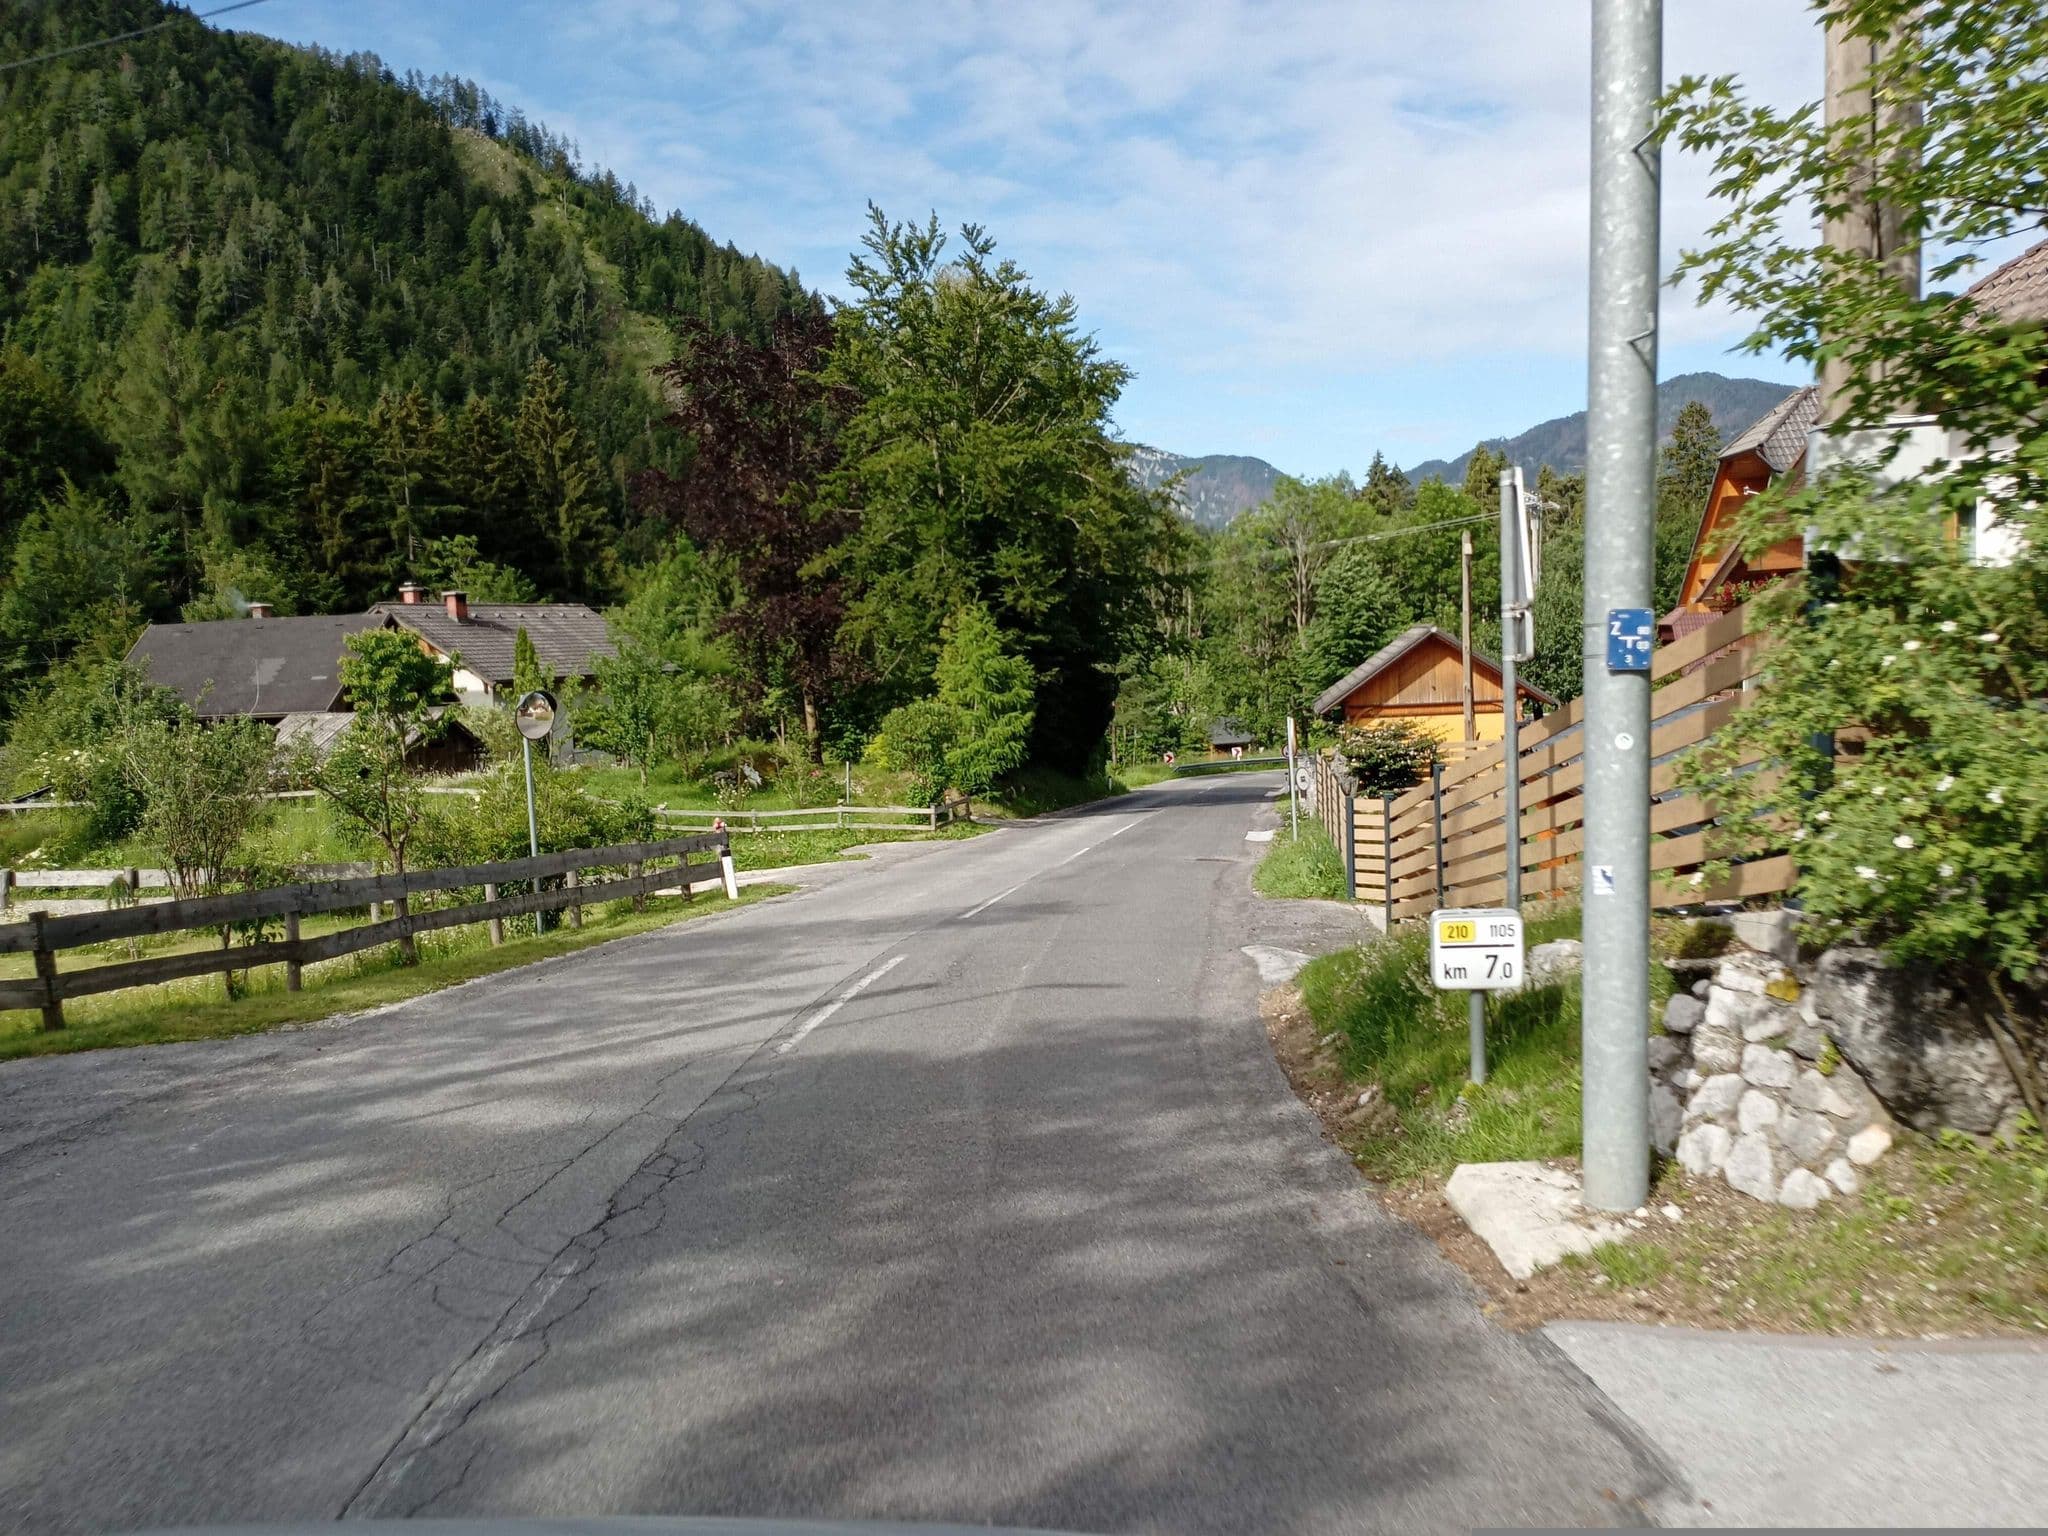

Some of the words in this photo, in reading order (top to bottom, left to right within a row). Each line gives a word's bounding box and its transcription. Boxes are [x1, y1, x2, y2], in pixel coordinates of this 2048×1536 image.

[1447, 925, 1468, 939] 210
[1490, 924, 1516, 938] 1105
[1444, 963, 1467, 979] km
